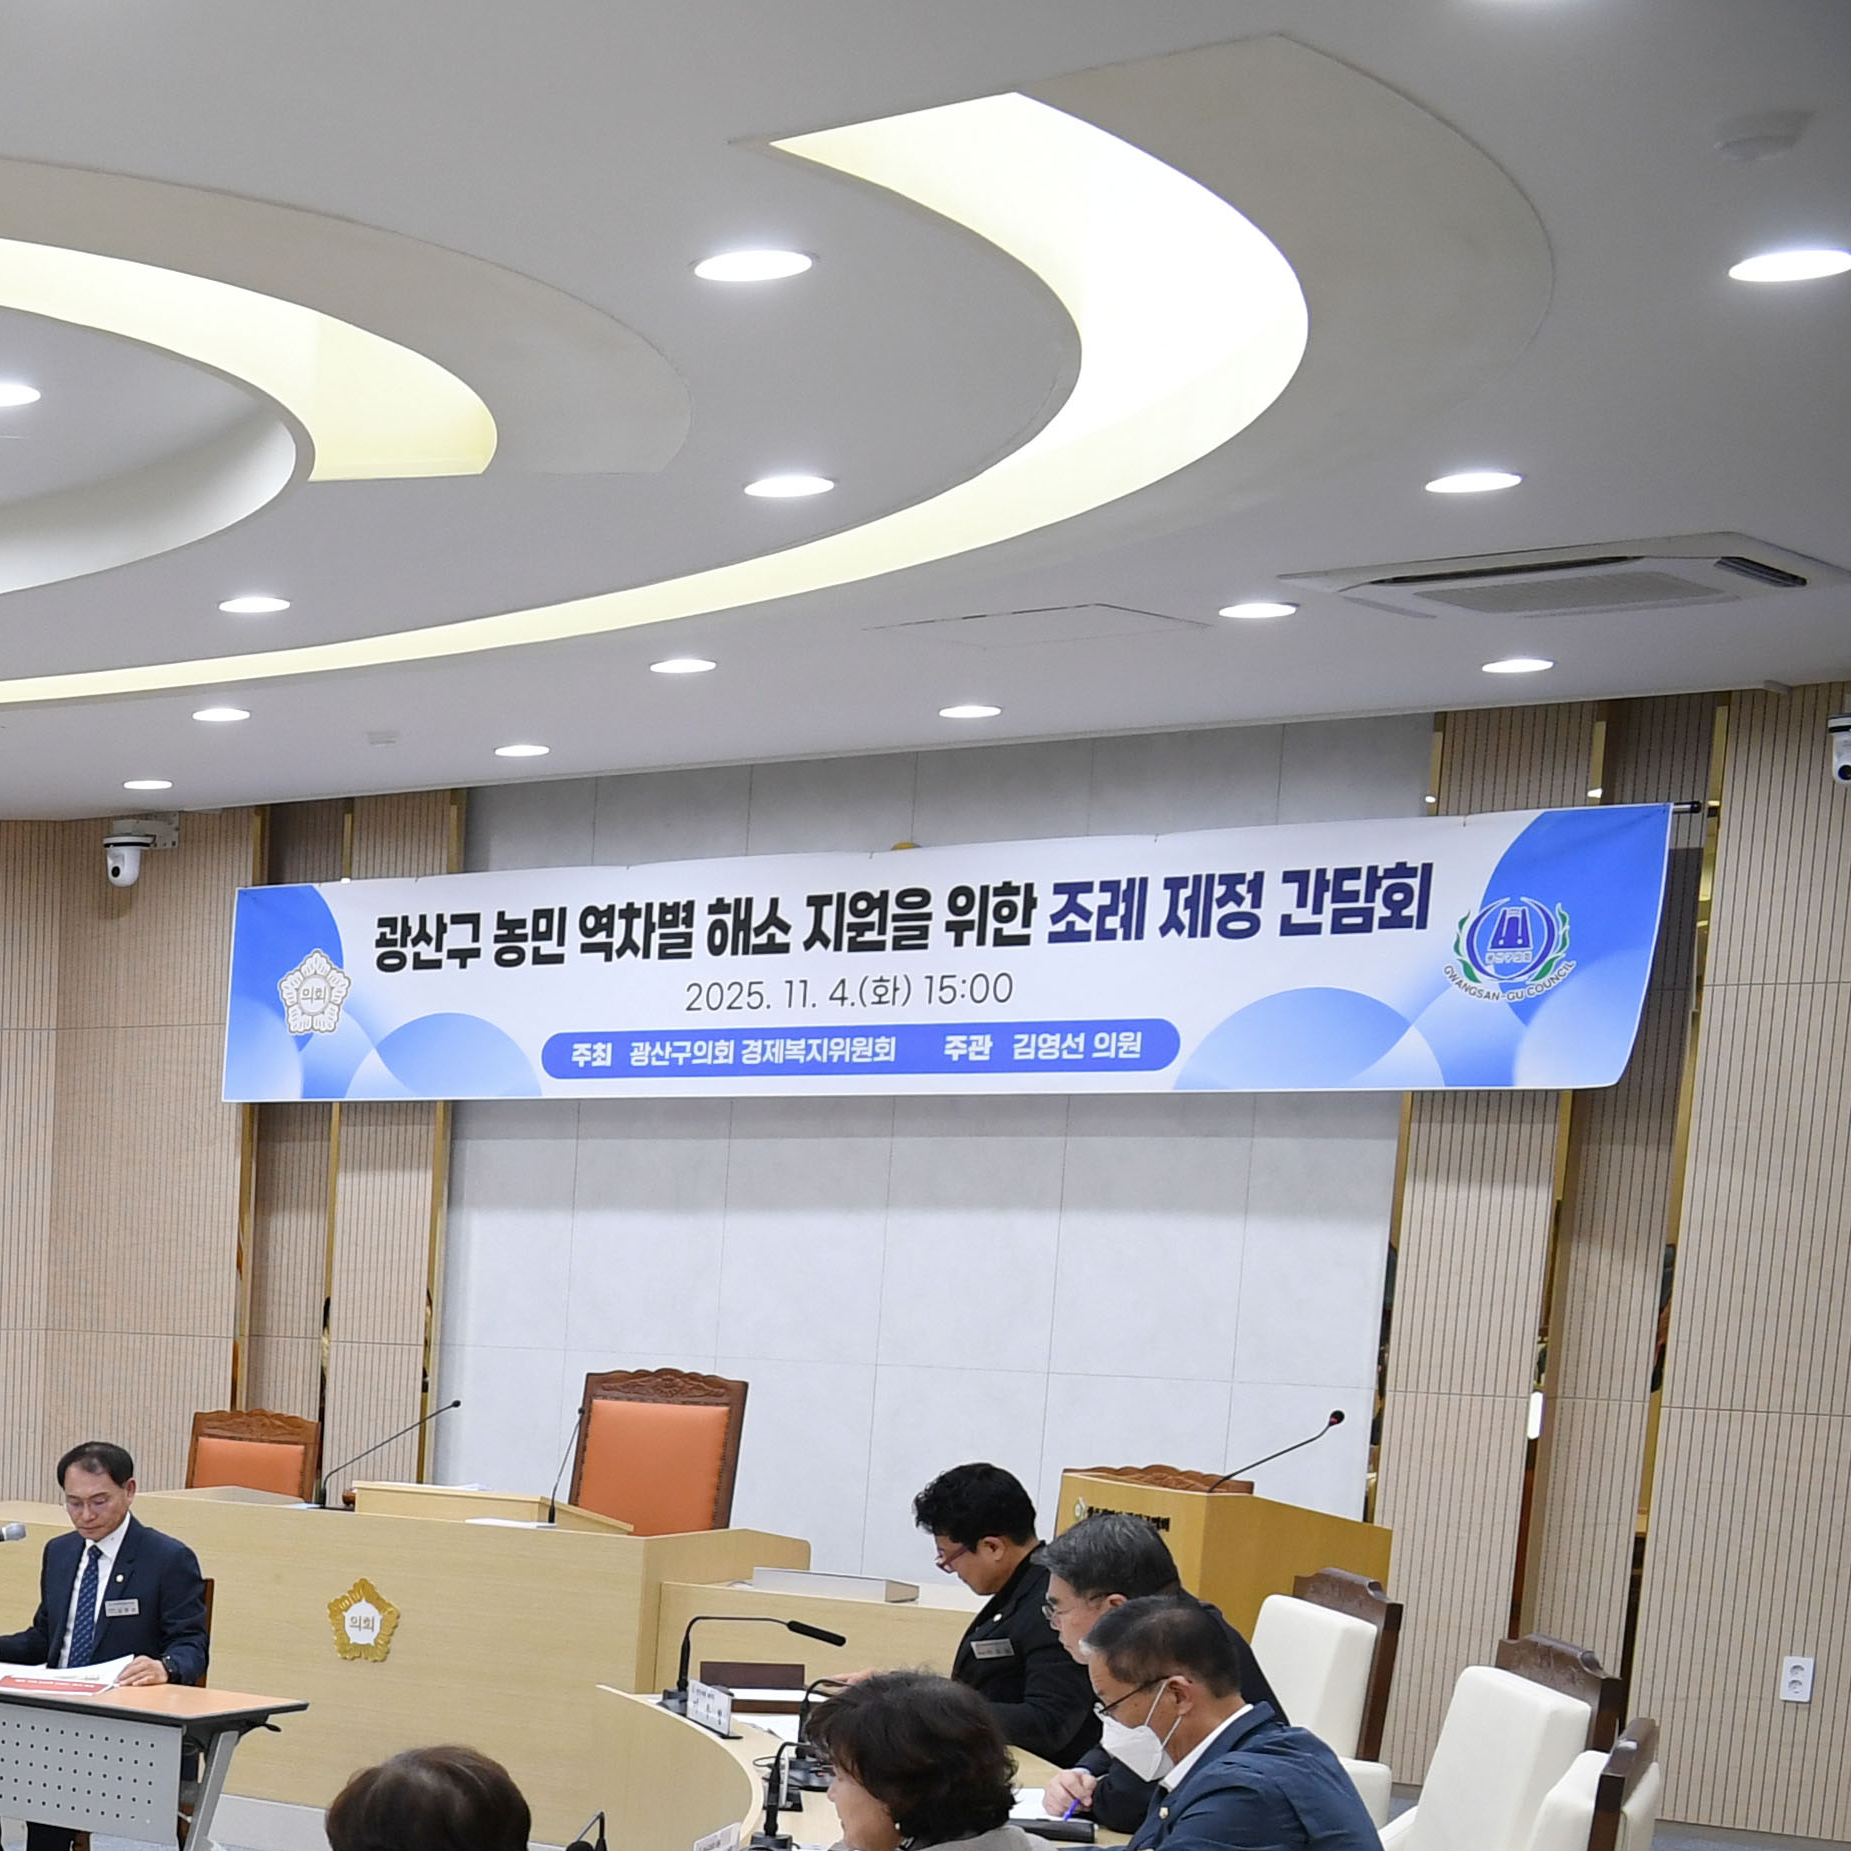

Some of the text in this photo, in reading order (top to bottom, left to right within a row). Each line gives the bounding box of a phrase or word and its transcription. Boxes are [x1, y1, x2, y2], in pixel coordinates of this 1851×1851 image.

[375, 862, 1433, 972] 광산구 농민 역차별 해소 지원을 위한 조례 제정 간담회
[301, 986, 326, 1004] 의회
[686, 972, 1014, 1012] 2025. 11. 4.(화) 15:00
[1444, 961, 1576, 1001] GWANGSAN-GU COUNCIL
[572, 1031, 1141, 1067] 주최 광산구의회 경제복지위원회 주관 김영선 의원
[349, 1615, 375, 1633] 의회
